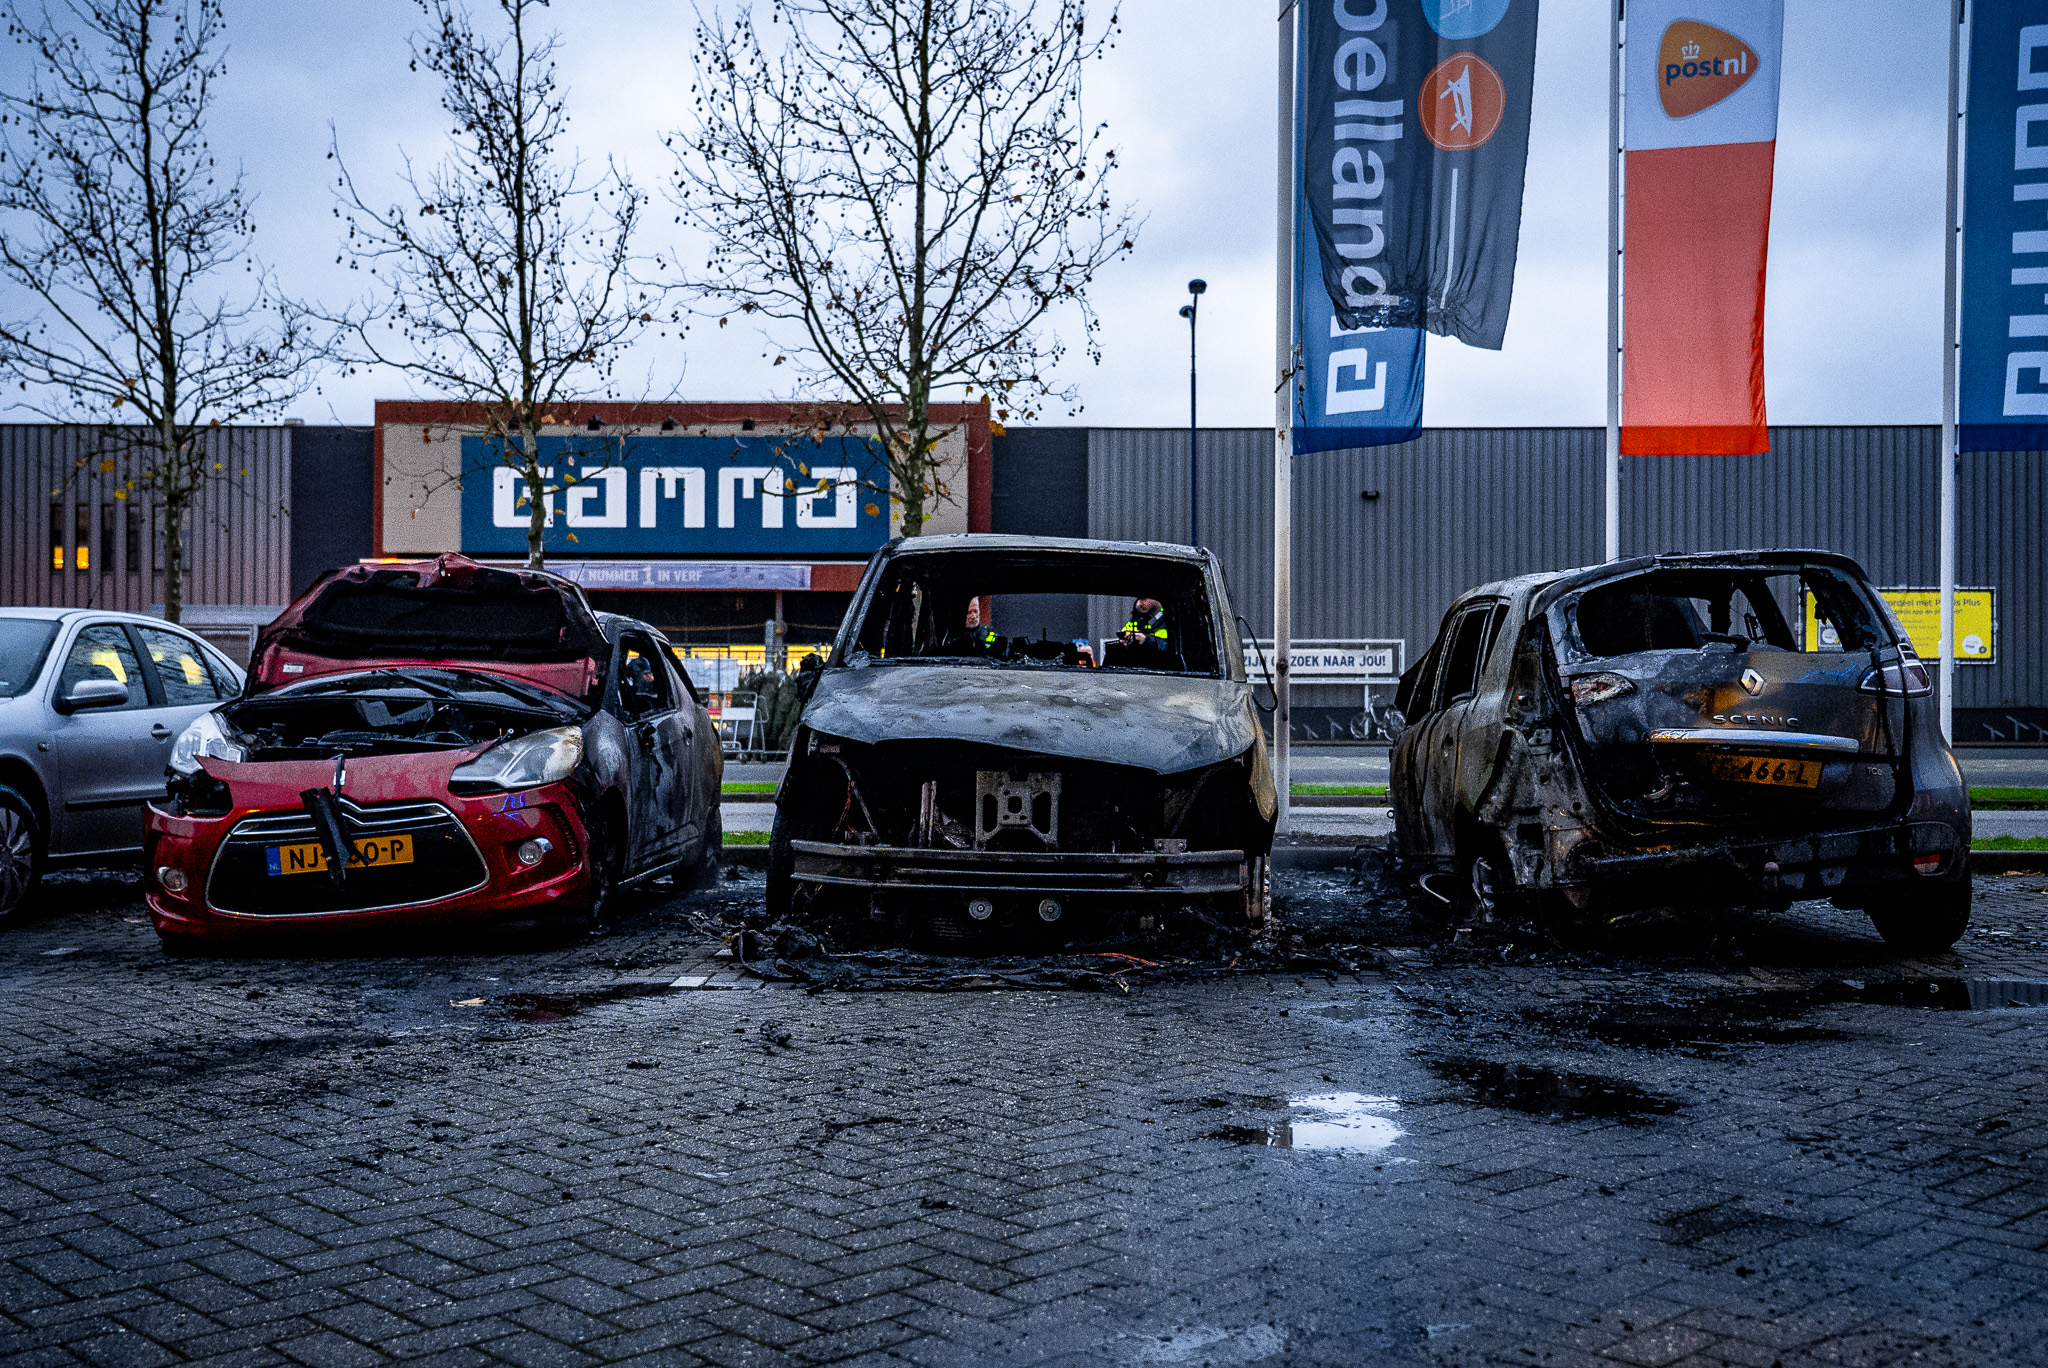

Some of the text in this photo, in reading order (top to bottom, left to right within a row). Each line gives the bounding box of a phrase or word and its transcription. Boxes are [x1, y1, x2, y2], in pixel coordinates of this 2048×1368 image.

[1665, 50, 1748, 87] postnl
[588, 568, 639, 582] NUMMER
[642, 566, 655, 586] 1
[657, 568, 671, 582] IN
[1290, 655, 1319, 667] ZOEK
[1323, 655, 1355, 667] NAAR
[1359, 655, 1386, 667] JOU!
[1712, 714, 1799, 728] SCENIC
